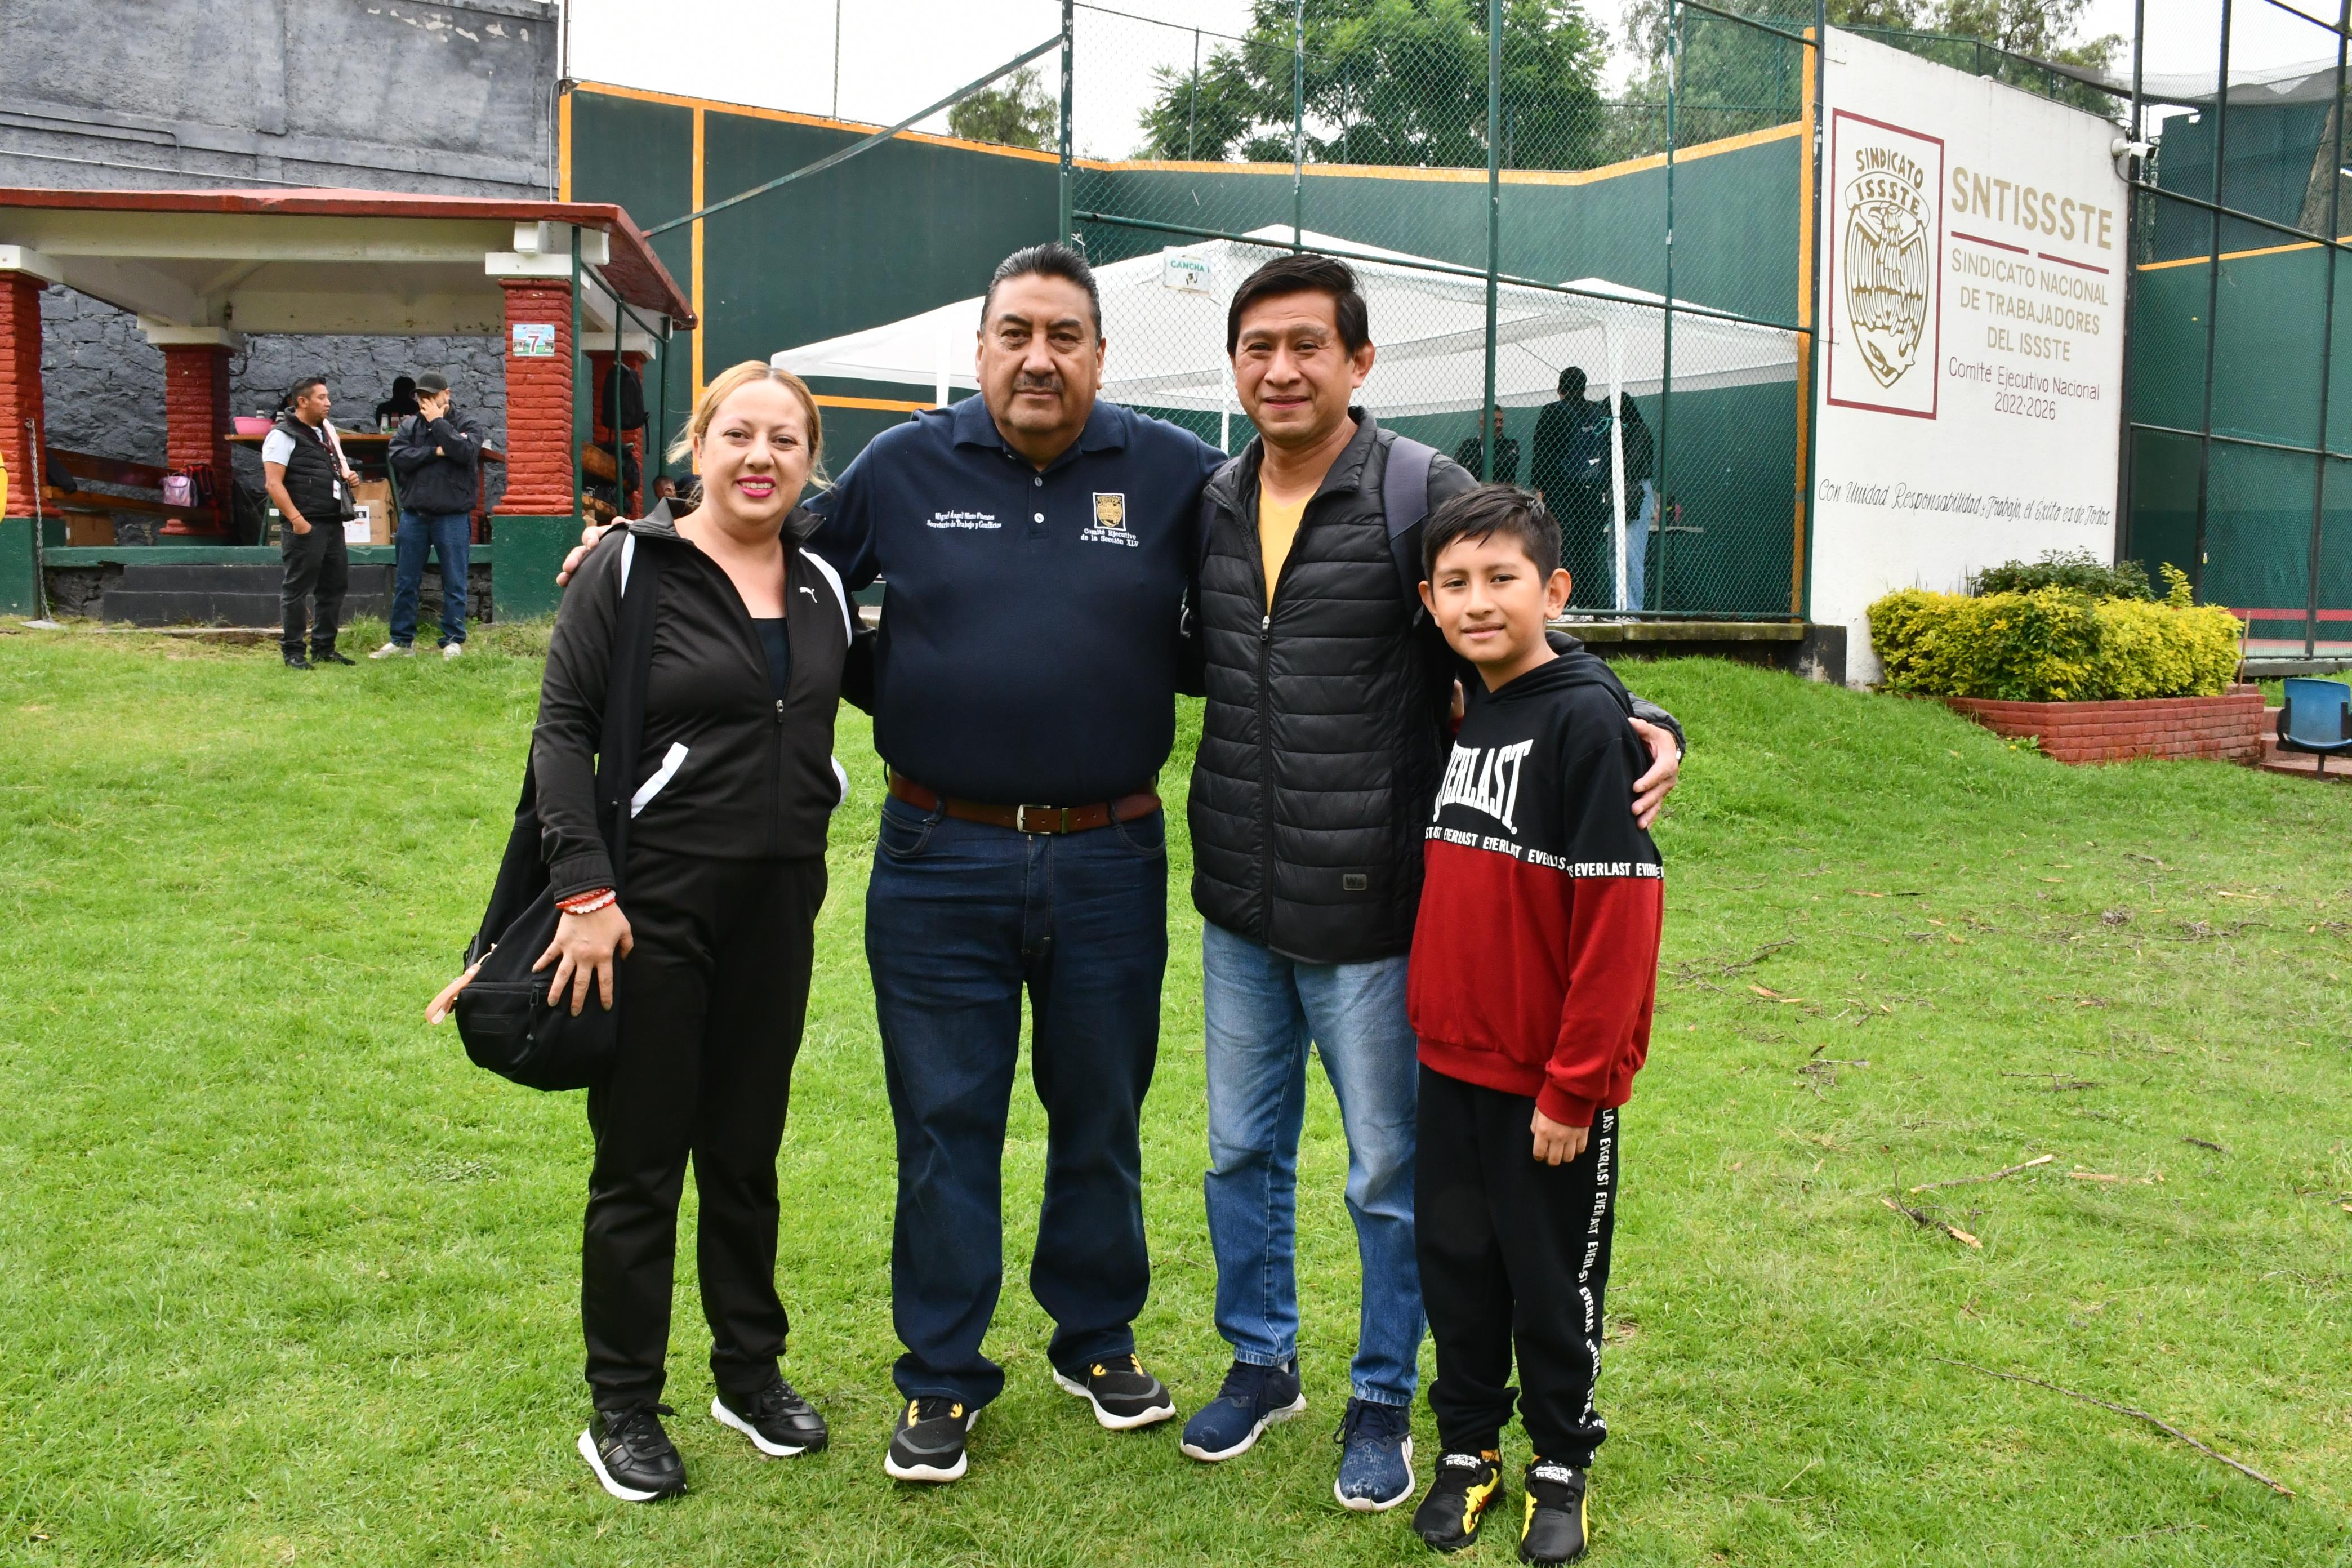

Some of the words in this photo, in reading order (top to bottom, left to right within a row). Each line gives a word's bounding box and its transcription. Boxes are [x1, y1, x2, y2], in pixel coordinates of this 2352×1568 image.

[1855, 146, 1923, 189] SINDICATO
[1858, 179, 1921, 216] ISSSTE
[1951, 166, 2113, 250] SNTISSSTE
[1170, 260, 1205, 273] CANCHA
[1952, 248, 2035, 287] SINDICATO
[2040, 271, 2109, 306] NACIONAL
[1960, 286, 1980, 310] DE
[1986, 291, 2100, 336] TRABAJADORES
[528, 336, 540, 353] 7
[1987, 326, 2015, 353] DEL
[2020, 332, 2070, 362] ISSSTE
[1949, 357, 1993, 384] Comité
[1998, 366, 2049, 393] Ejecutivo
[2053, 378, 2100, 401] Nacional
[950, 519, 956, 528] de
[1818, 479, 1841, 502] Con
[1846, 481, 1890, 506] Unidad
[1891, 482, 1982, 516] Responsabilidad
[2024, 500, 2035, 519] el
[2074, 505, 2084, 523] de
[2083, 505, 2110, 525] Todos
[1084, 527, 1106, 536] Comité
[1108, 529, 1137, 540] Ejecutivo
[1100, 535, 1124, 545] Sección
[1126, 538, 1139, 547] XLV
[1574, 862, 1631, 877] EVERLAST
[1597, 1137, 1611, 1186] EVERLAST
[1587, 1192, 1608, 1235] EVERAST
[1579, 1286, 1594, 1333] EVERLAS
